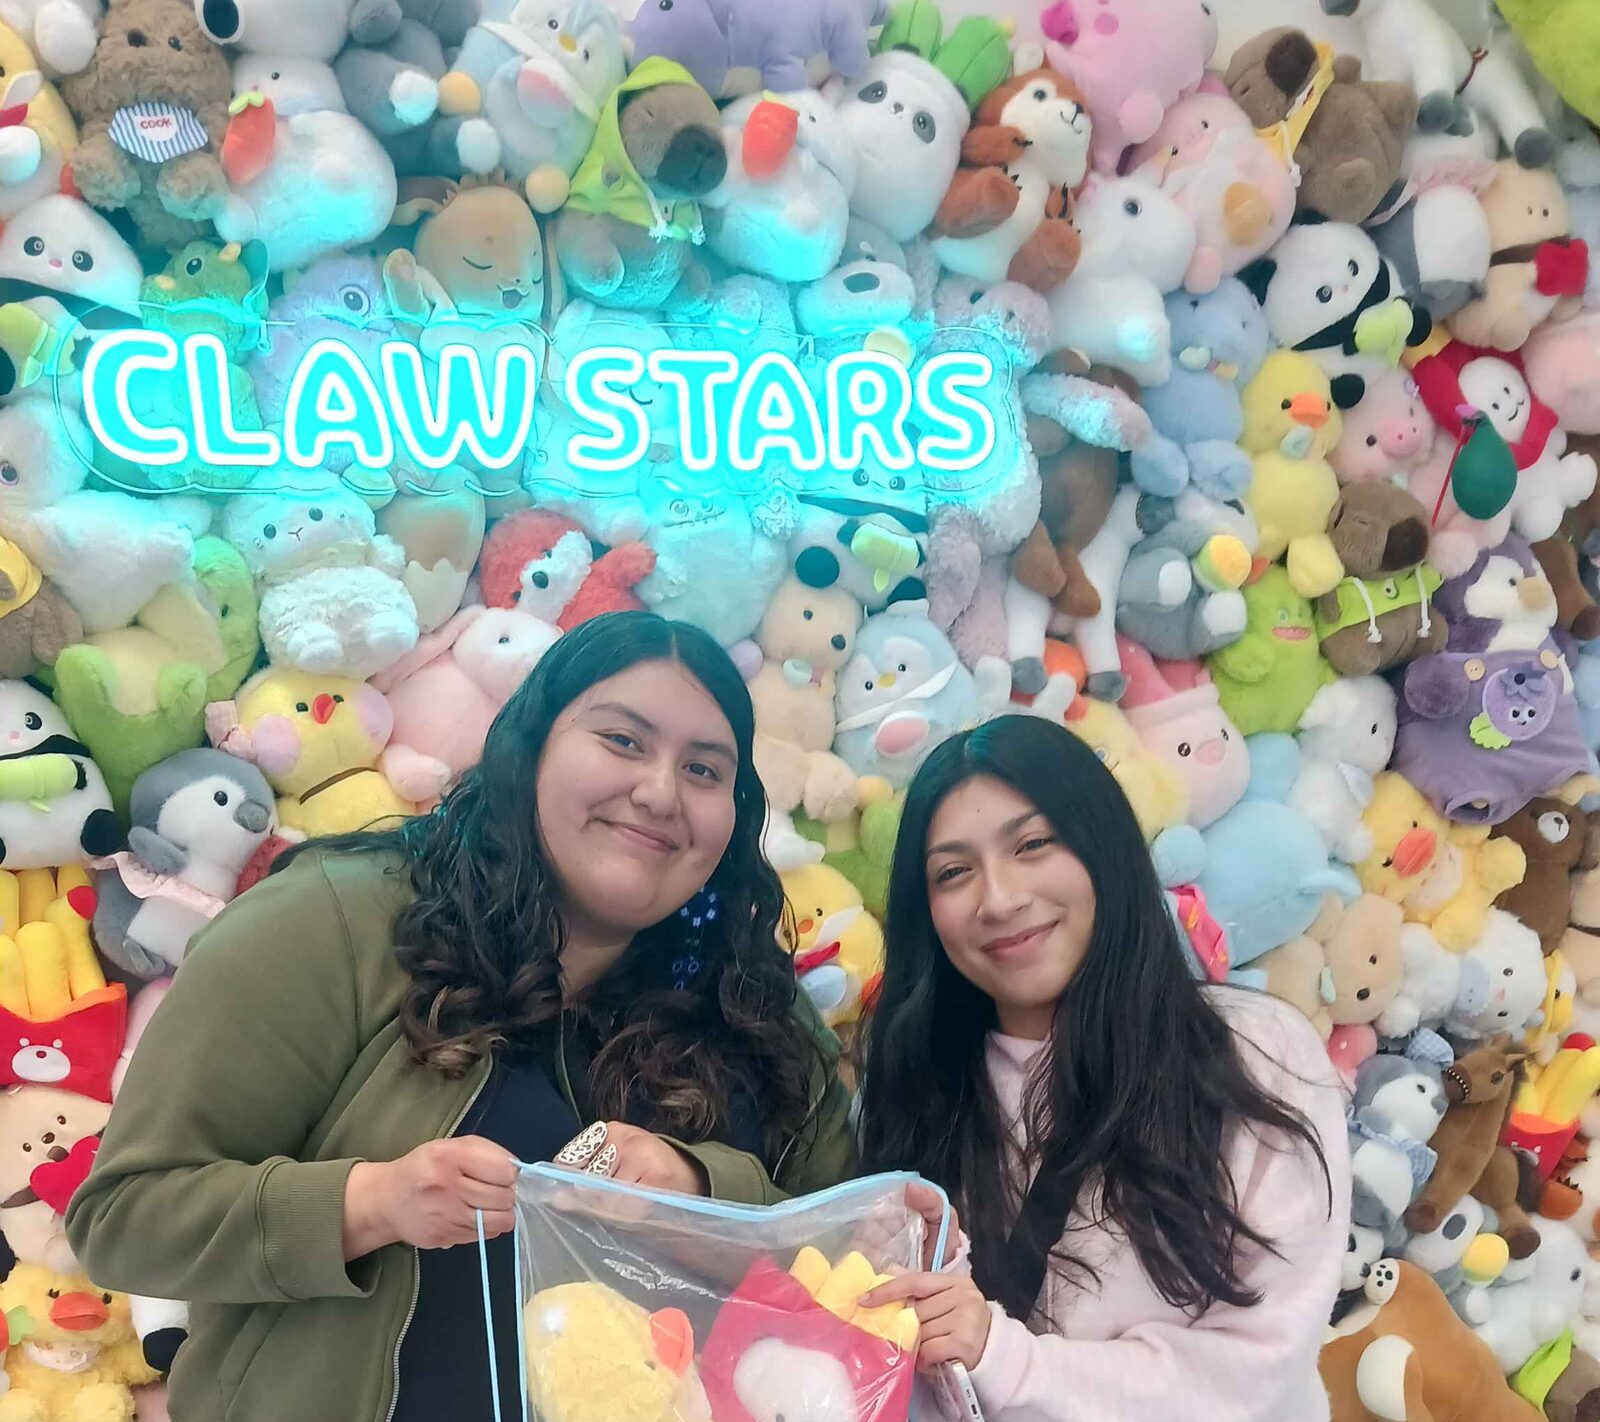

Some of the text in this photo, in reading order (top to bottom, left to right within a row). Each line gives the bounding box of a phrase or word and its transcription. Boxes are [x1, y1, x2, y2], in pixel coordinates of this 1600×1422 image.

[140, 118, 172, 129] COOK
[82, 328, 996, 471] CLAW STARS
